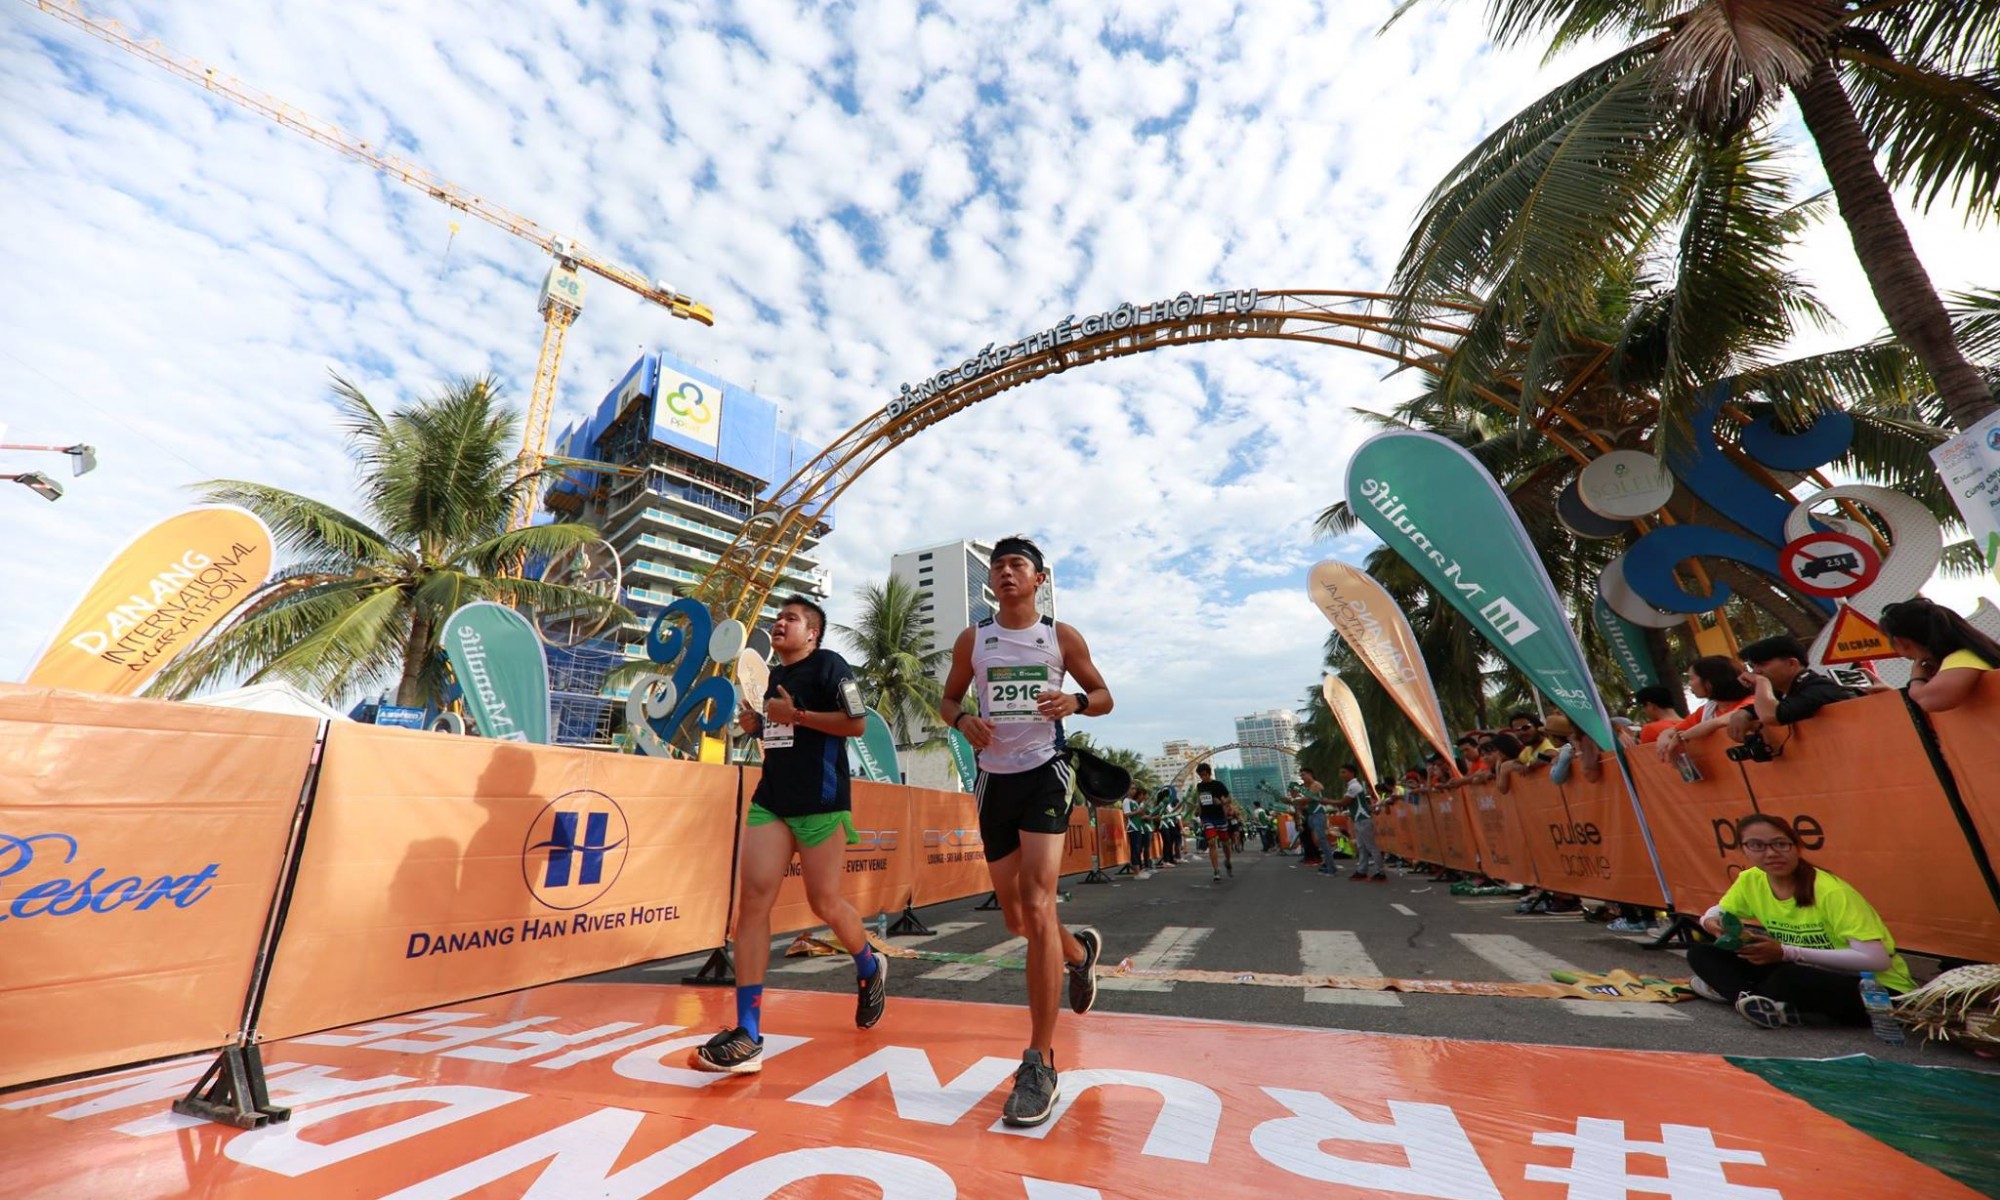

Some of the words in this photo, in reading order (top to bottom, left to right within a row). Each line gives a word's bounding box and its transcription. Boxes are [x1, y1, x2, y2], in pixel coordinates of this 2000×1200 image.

[959, 342, 1013, 381] CẤP
[1018, 314, 1075, 357] THẾ
[1080, 302, 1141, 337] GIỚI
[1150, 291, 1206, 322] HỘI
[1214, 288, 1259, 316] TỤ
[1825, 557, 1841, 568] 2.5
[70, 549, 212, 656] DANANG
[100, 541, 258, 667] INTERNATIONAL
[127, 572, 248, 672] MARATHON
[992, 684, 1042, 701] 2916
[1549, 821, 1602, 850] pulse
[847, 860, 868, 873] EVENT
[868, 858, 887, 872] VENUE
[1562, 852, 1613, 880] active
[406, 926, 514, 959] DANANG
[520, 918, 567, 942] HAN
[572, 911, 626, 934] RIVER
[629, 905, 681, 926] HOTEL
